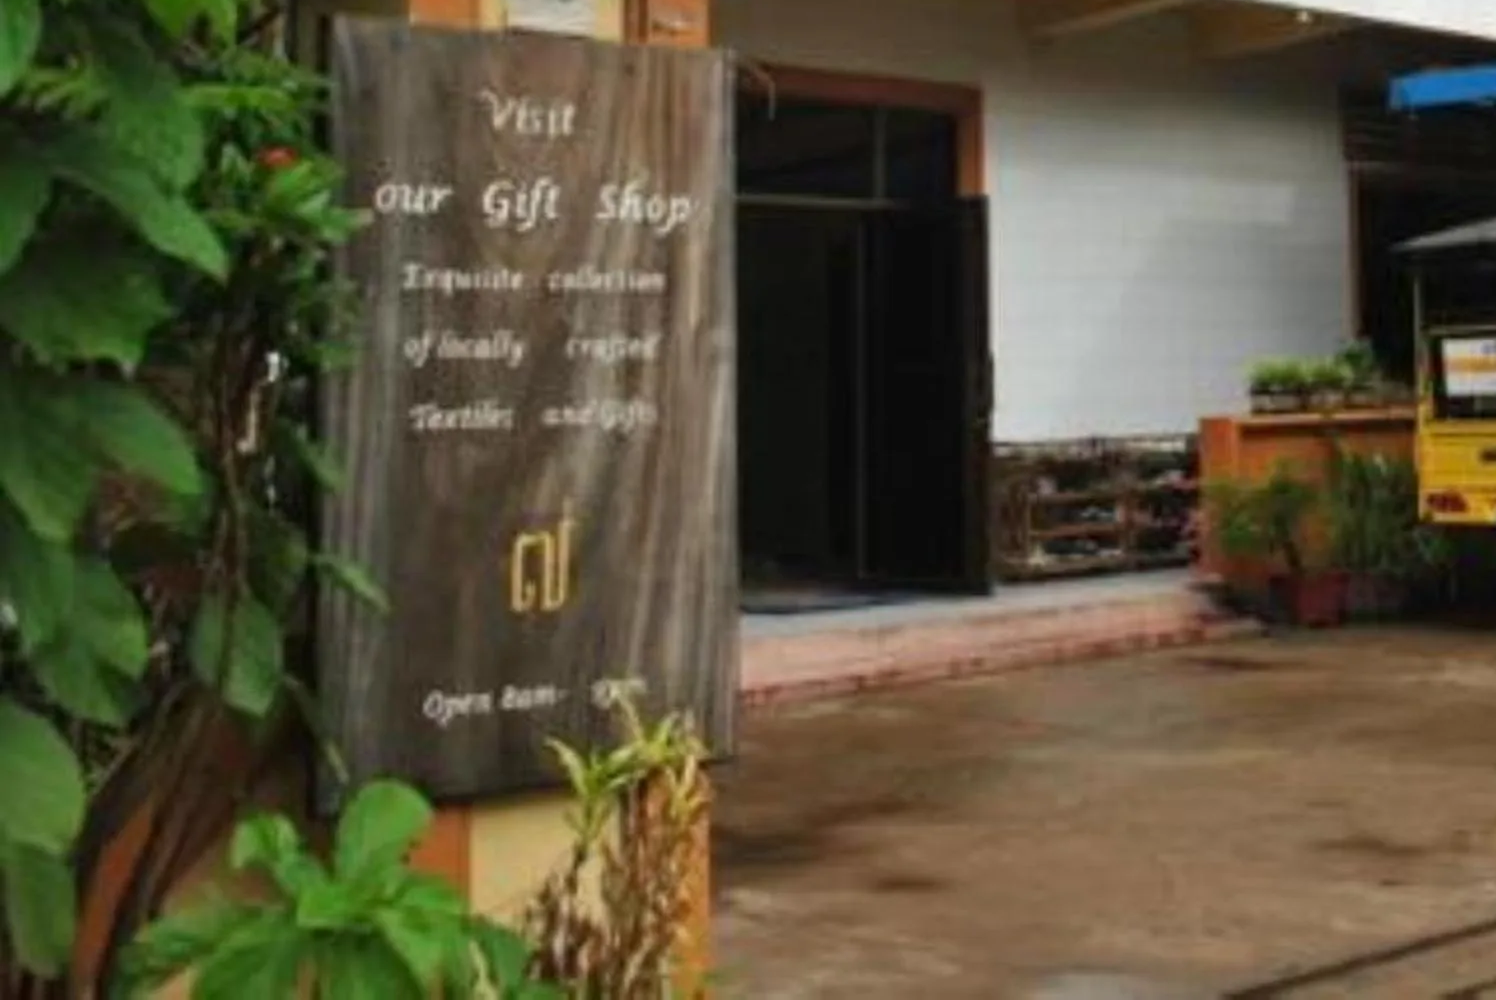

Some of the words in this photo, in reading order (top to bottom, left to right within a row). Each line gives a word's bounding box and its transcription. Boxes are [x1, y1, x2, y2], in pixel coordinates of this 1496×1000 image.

[478, 88, 577, 138] Visit
[374, 181, 453, 216] our
[481, 176, 561, 230] Gift
[595, 174, 698, 237] Shop
[547, 264, 666, 292] collection
[402, 329, 432, 369] of
[437, 329, 525, 367] locally
[566, 333, 663, 365] crafted
[409, 399, 515, 431] Textiles
[422, 689, 491, 729] Open
